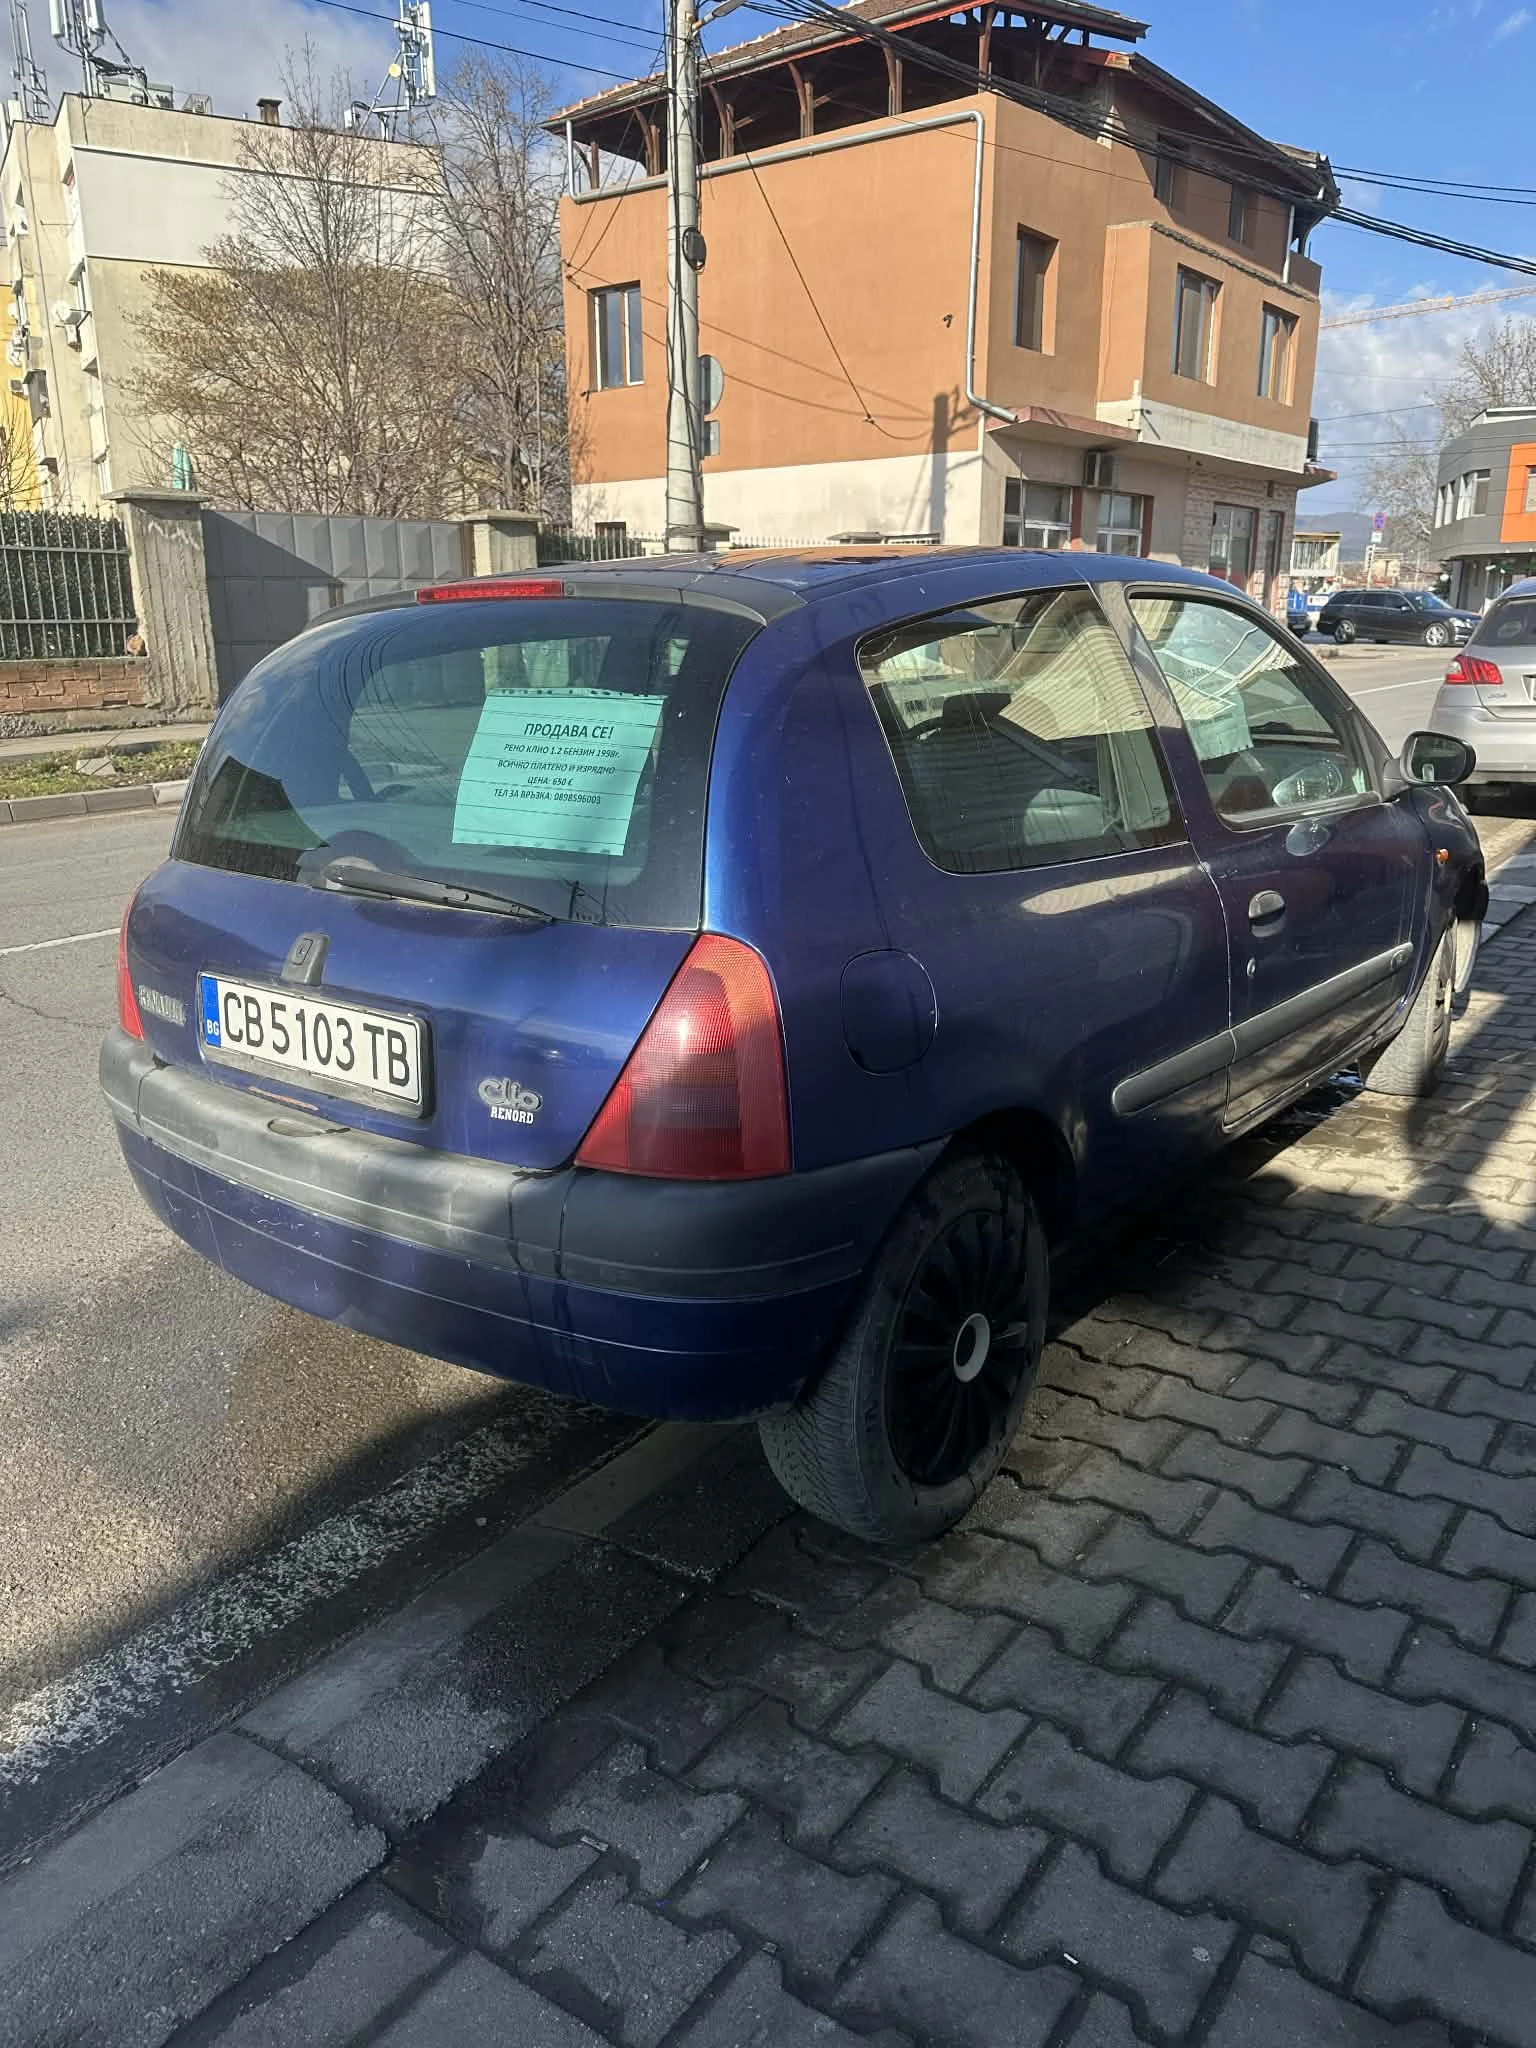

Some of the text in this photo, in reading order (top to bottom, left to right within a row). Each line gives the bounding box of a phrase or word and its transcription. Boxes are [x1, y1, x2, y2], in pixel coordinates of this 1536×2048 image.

[523, 723, 614, 739] ПРОДАВА СЕ!
[504, 743, 526, 752] РЕНО
[527, 745, 549, 754] КЛИО
[550, 747, 562, 755] 1.2
[564, 747, 595, 757] БЕНЗИН
[497, 759, 529, 769] ВСИЧКО
[530, 761, 567, 771] ПЛАТЕНО
[576, 764, 616, 775] ИЗРЯДНО
[527, 776, 574, 786] ЦЕНА: 650 €
[494, 788, 508, 797] ТЕЛ
[509, 789, 519, 798] ЗА
[520, 790, 551, 800] ВРЪЗКА:
[206, 1018, 219, 1036] BG
[478, 1076, 543, 1112] Clio
[490, 1105, 534, 1124] RENORD
